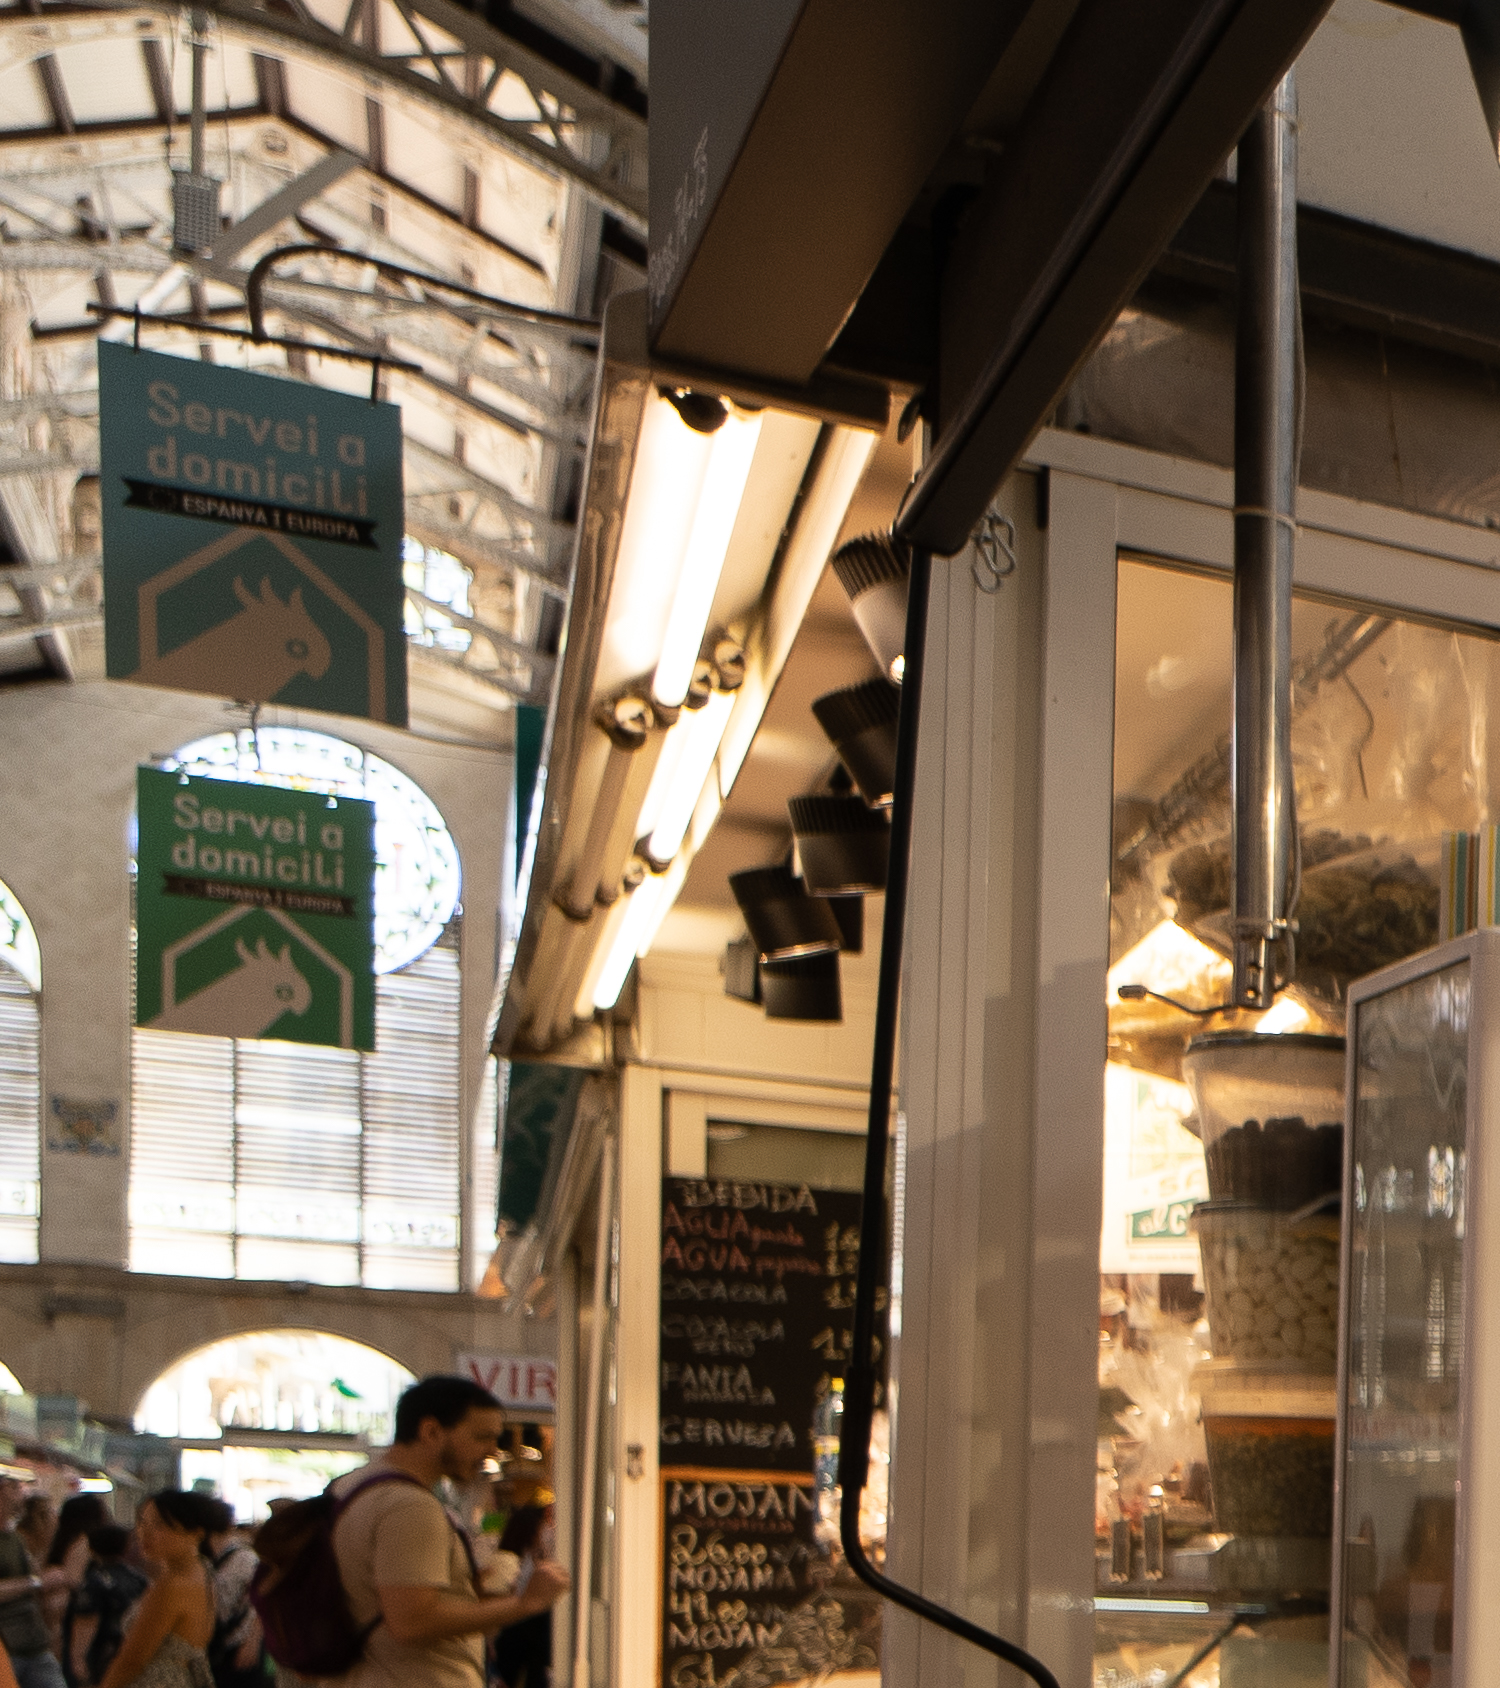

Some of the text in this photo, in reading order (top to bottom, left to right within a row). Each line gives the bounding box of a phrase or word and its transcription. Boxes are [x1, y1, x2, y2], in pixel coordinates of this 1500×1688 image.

[149, 380, 365, 466] Servei a
[147, 436, 368, 516] domicili
[182, 495, 268, 525] ESPANYA
[287, 514, 359, 541] EUROPA
[174, 792, 344, 849] Servei a
[171, 834, 344, 889] domicili
